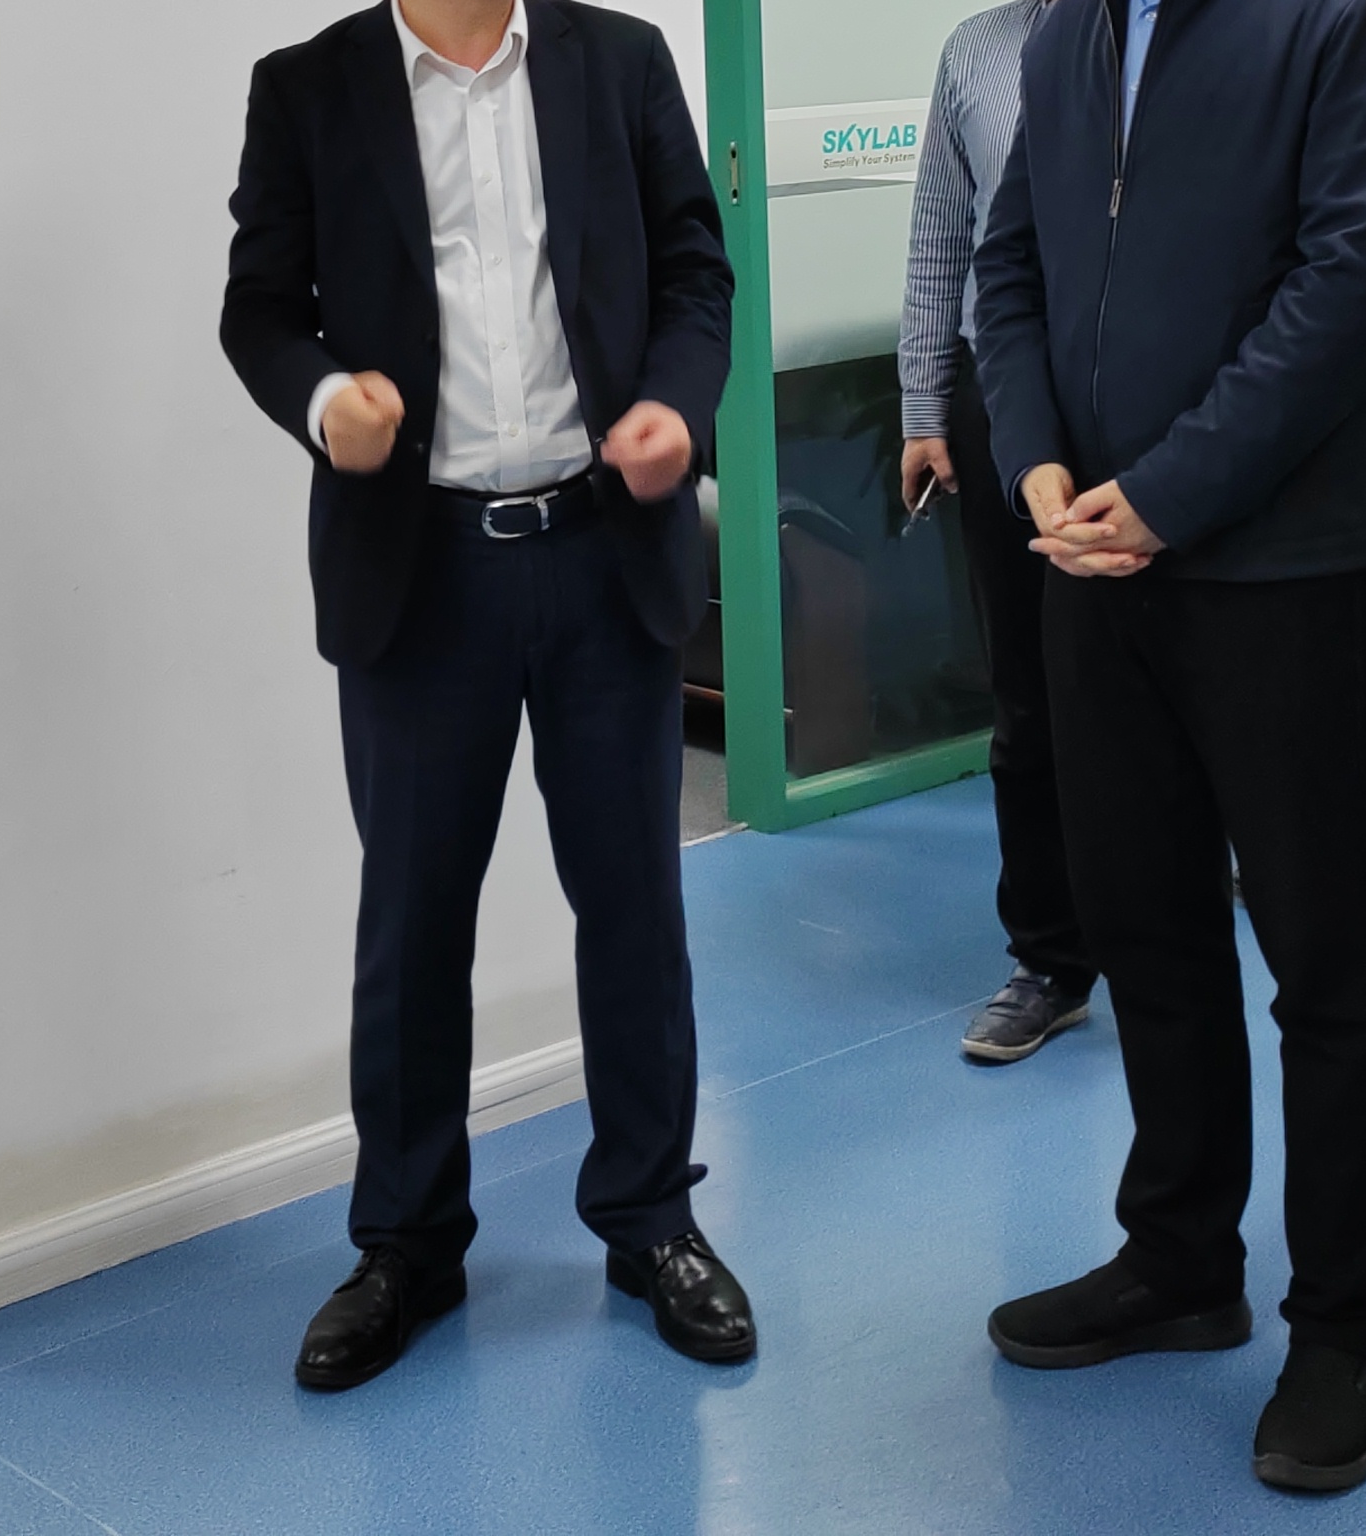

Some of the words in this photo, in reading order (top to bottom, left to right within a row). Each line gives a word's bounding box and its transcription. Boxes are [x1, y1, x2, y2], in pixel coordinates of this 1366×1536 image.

[822, 123, 917, 155] SKYLAB
[823, 156, 860, 169] Simplify
[861, 155, 882, 165] Your
[883, 153, 915, 165] System
